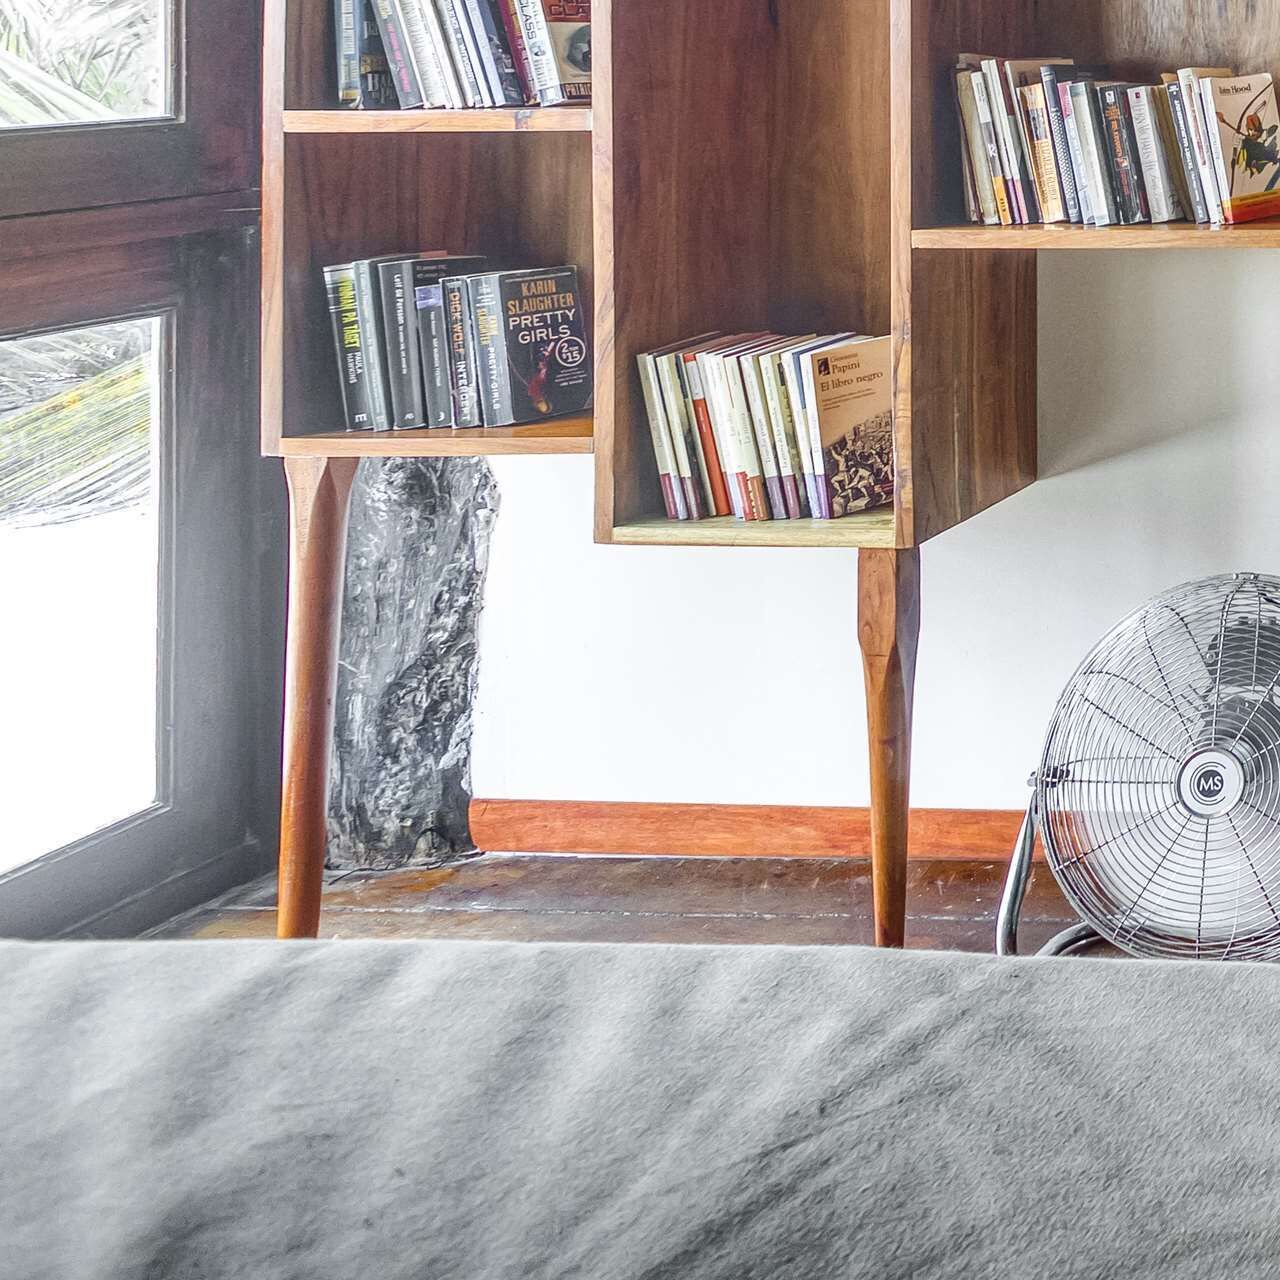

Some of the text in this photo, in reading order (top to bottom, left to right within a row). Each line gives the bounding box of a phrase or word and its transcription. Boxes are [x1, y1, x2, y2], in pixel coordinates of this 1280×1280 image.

[521, 279, 557, 297] KARIN
[507, 291, 575, 315] SLAUGHTER
[448, 291, 465, 352] DICK WOLF
[509, 308, 576, 330] PRETTY
[518, 325, 571, 344] GIRLS
[346, 353, 358, 383] HAWKINS
[354, 351, 363, 373] PAULA
[832, 362, 860, 374] Papini
[486, 347, 500, 409] PRETTY GIRLS
[820, 371, 883, 392] El libro negro
[456, 360, 471, 421] INTERCEPT
[1200, 776, 1221, 791] MS
